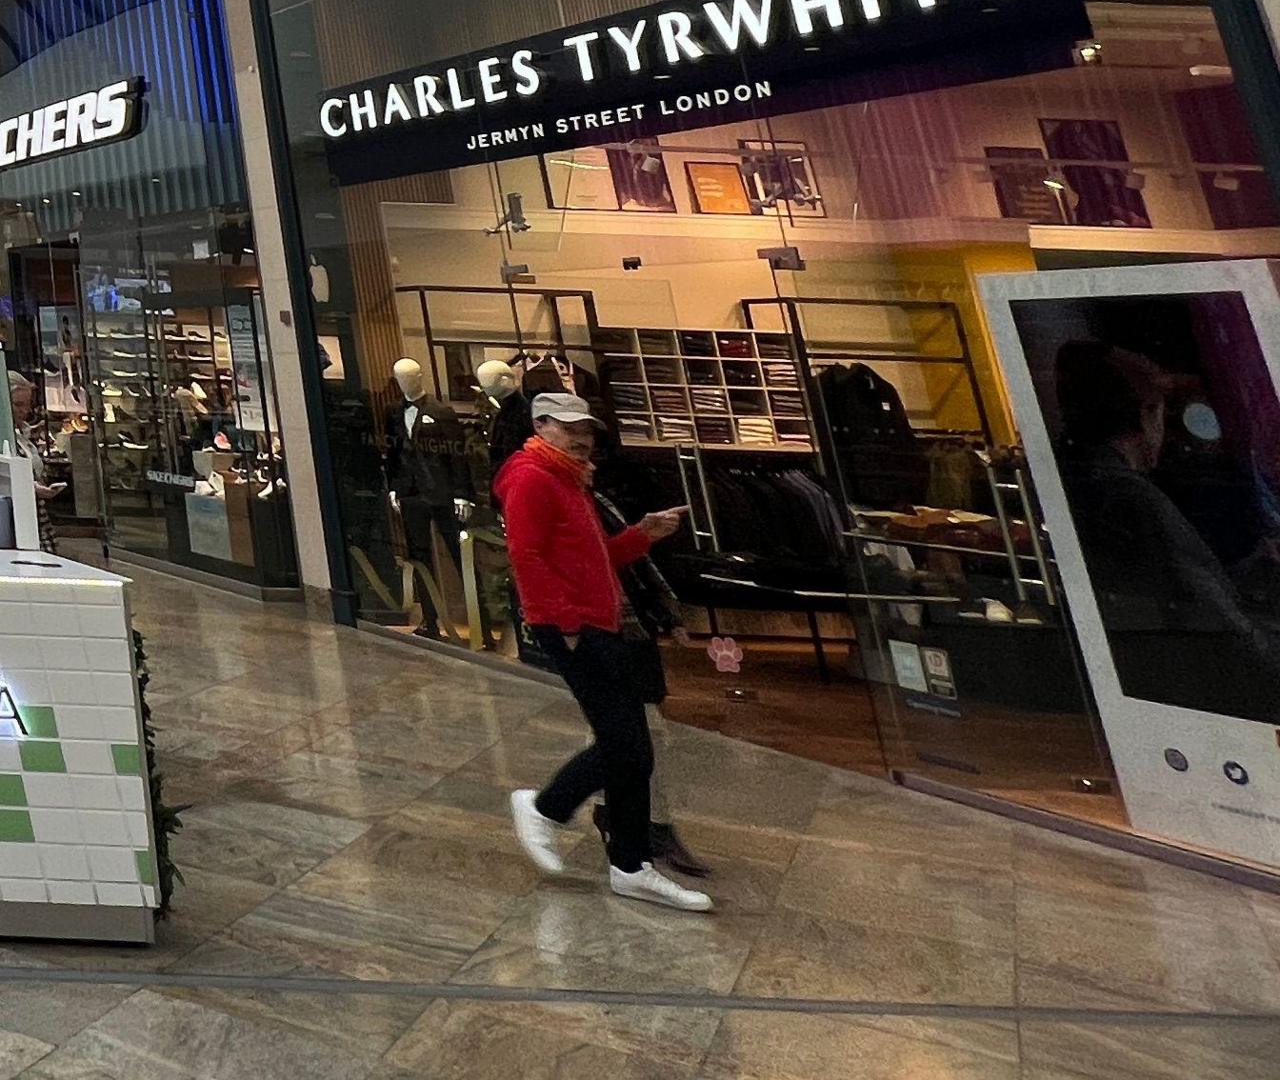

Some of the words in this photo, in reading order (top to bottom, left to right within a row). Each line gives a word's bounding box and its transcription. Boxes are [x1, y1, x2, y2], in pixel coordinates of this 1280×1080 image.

[319, 48, 542, 139] CHARLES
[466, 122, 545, 151] JERMYN
[556, 104, 646, 134] STREET
[660, 81, 773, 116] LONDON
